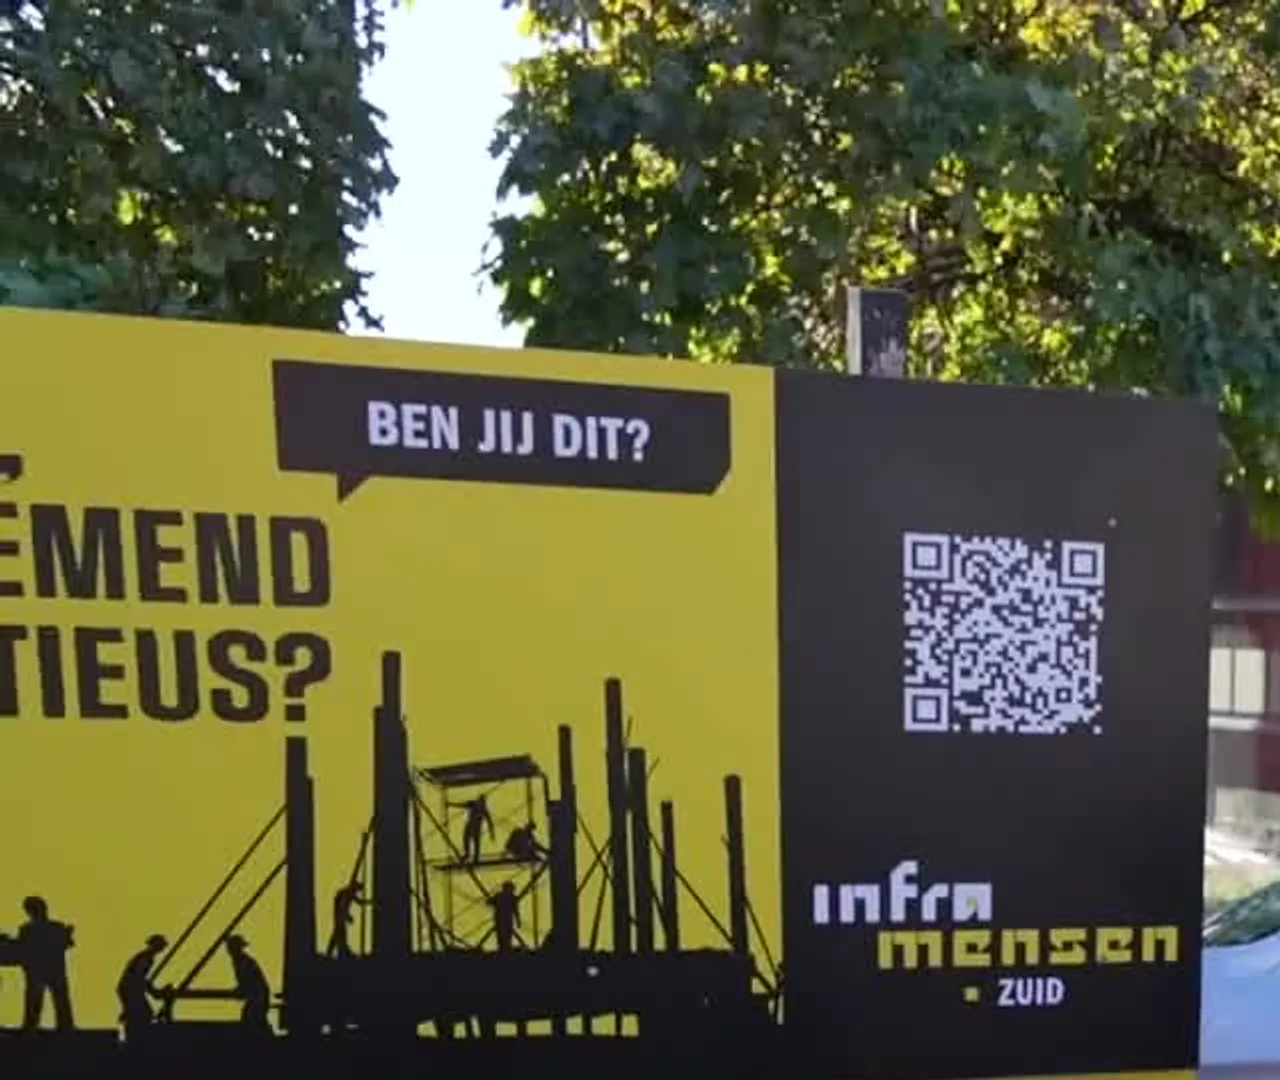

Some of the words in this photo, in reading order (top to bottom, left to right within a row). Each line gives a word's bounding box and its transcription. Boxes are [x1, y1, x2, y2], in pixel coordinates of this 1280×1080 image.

[367, 400, 460, 450] BEN
[478, 407, 534, 455] JIJ
[552, 412, 650, 461] DIT?
[0, 624, 332, 722] TIEUS?
[813, 860, 992, 924] infra
[877, 926, 1178, 969] mensen
[997, 977, 1066, 1007] ZUID
